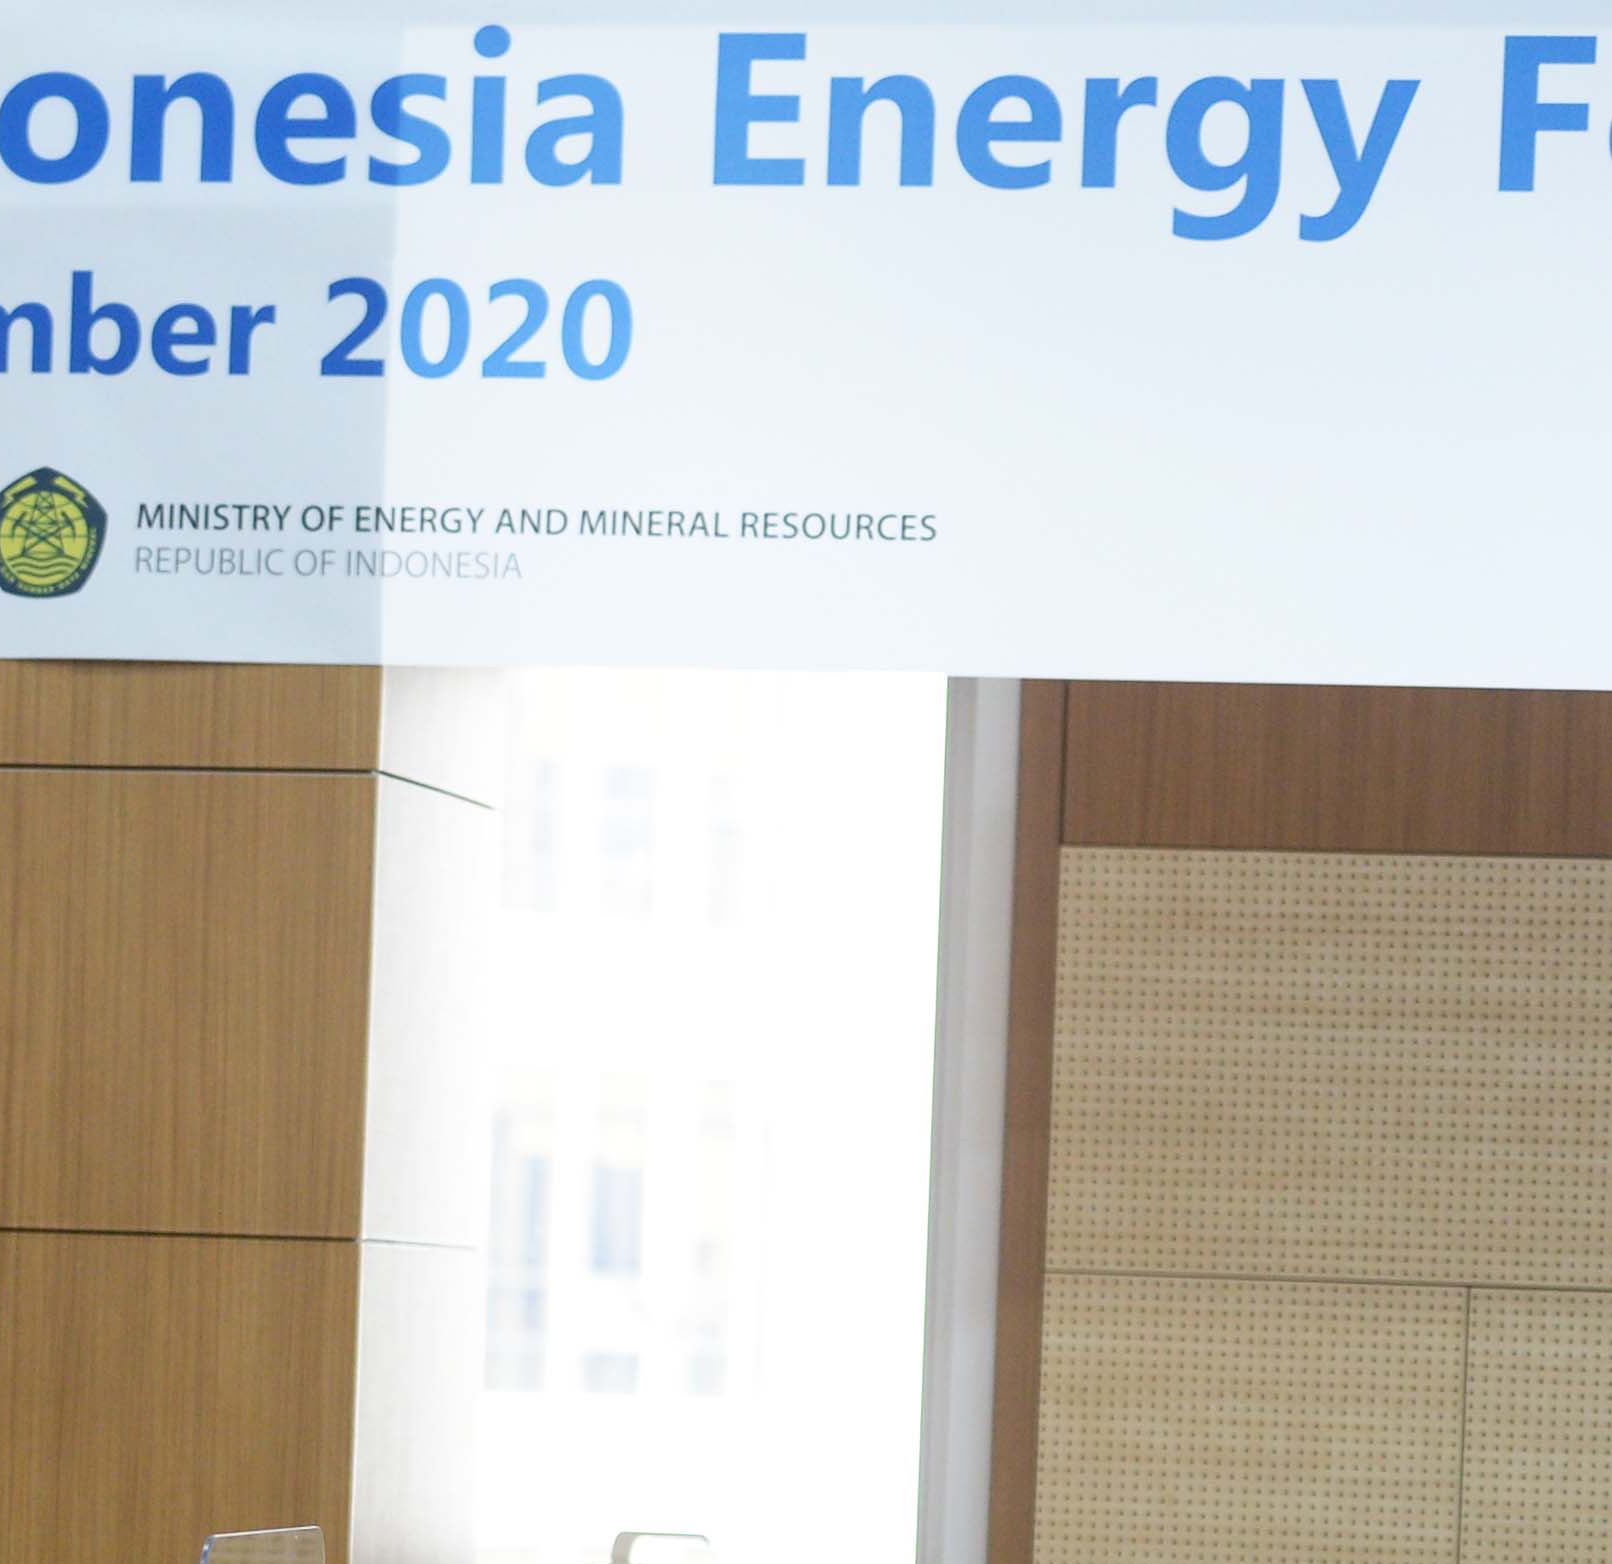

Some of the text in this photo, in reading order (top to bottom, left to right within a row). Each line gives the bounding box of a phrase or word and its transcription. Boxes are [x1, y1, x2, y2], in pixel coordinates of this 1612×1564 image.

[713, 33, 1420, 242] Energy
[1499, 36, 1612, 192] F
[320, 277, 631, 380] 2020
[136, 502, 937, 542] MINISTRY OF ENERGY AND MINERAL RESOURCES
[134, 546, 524, 579] REPUBLIC OF INDONESIA
